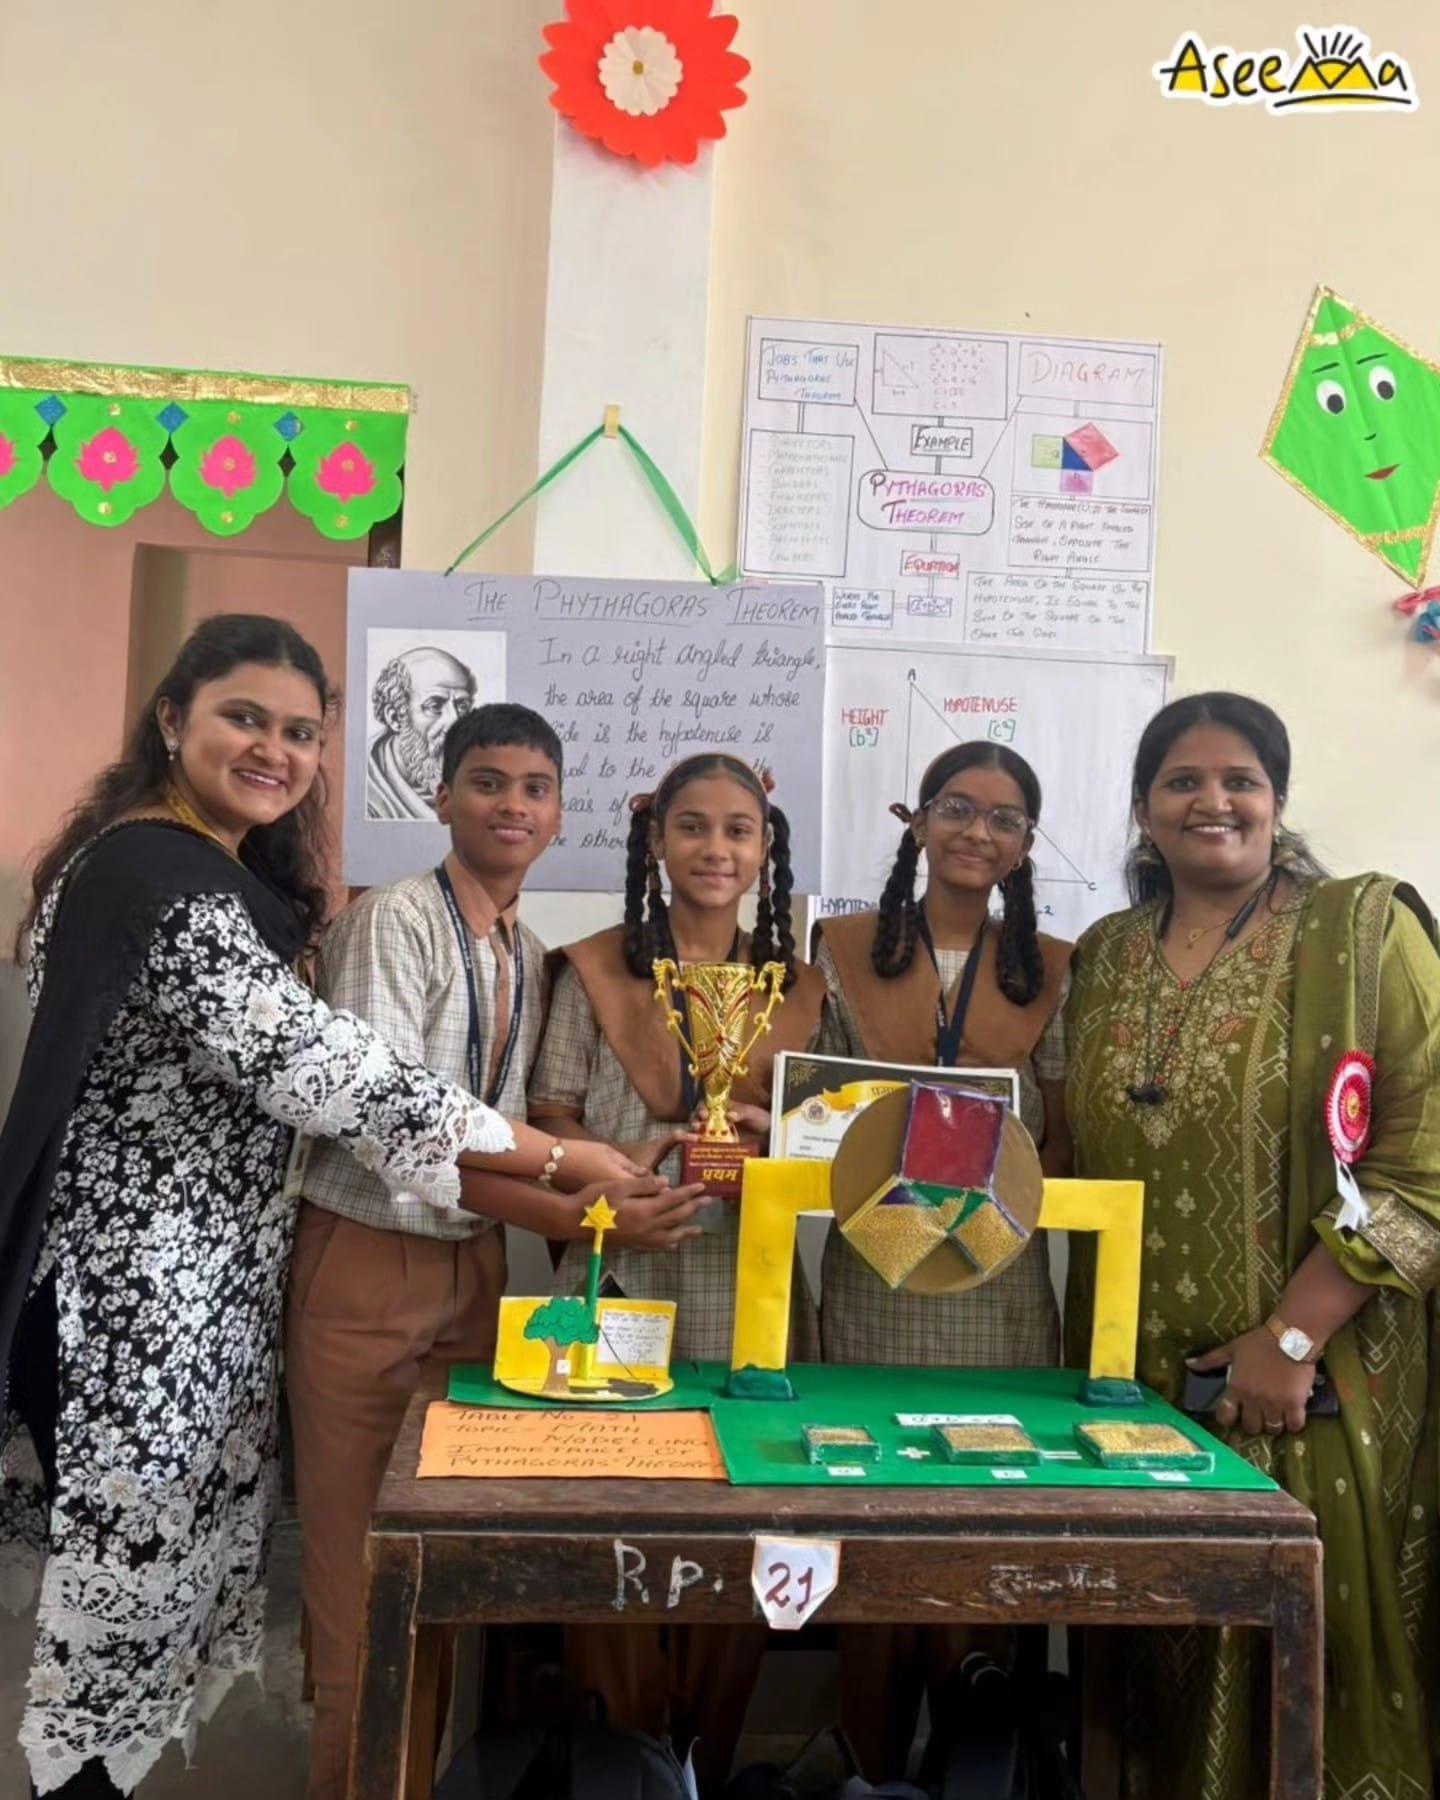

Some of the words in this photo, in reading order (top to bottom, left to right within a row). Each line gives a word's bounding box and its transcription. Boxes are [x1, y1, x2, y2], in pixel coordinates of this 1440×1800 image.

[1026, 351, 1146, 387] DIAGRAM
[914, 426, 970, 452] EXAMPLE
[870, 472, 988, 498] PYTHAGORAS
[881, 499, 965, 524] THEOREM
[463, 581, 506, 612] THE
[533, 579, 709, 618] PHYTHAGORAS
[726, 586, 820, 625] THEOREM
[537, 638, 571, 665] In
[612, 639, 664, 682] right
[675, 639, 744, 681] angled
[752, 640, 821, 681] triangle,
[907, 668, 917, 681] A
[544, 684, 569, 706] the
[575, 690, 615, 706] area
[623, 685, 645, 716] of
[648, 685, 673, 706] the
[683, 690, 738, 718] square
[750, 684, 801, 707] whose
[841, 707, 890, 727] HEIGHT
[943, 696, 1018, 714] HYPOTENUSE
[593, 722, 611, 743] is
[625, 720, 648, 743] the
[659, 720, 742, 758] hypotenuse
[752, 720, 773, 743] is
[563, 752, 589, 777] ual
[598, 756, 617, 778] to
[625, 757, 656, 779] the
[608, 790, 629, 826] of
[764, 1561, 814, 1612] 21
